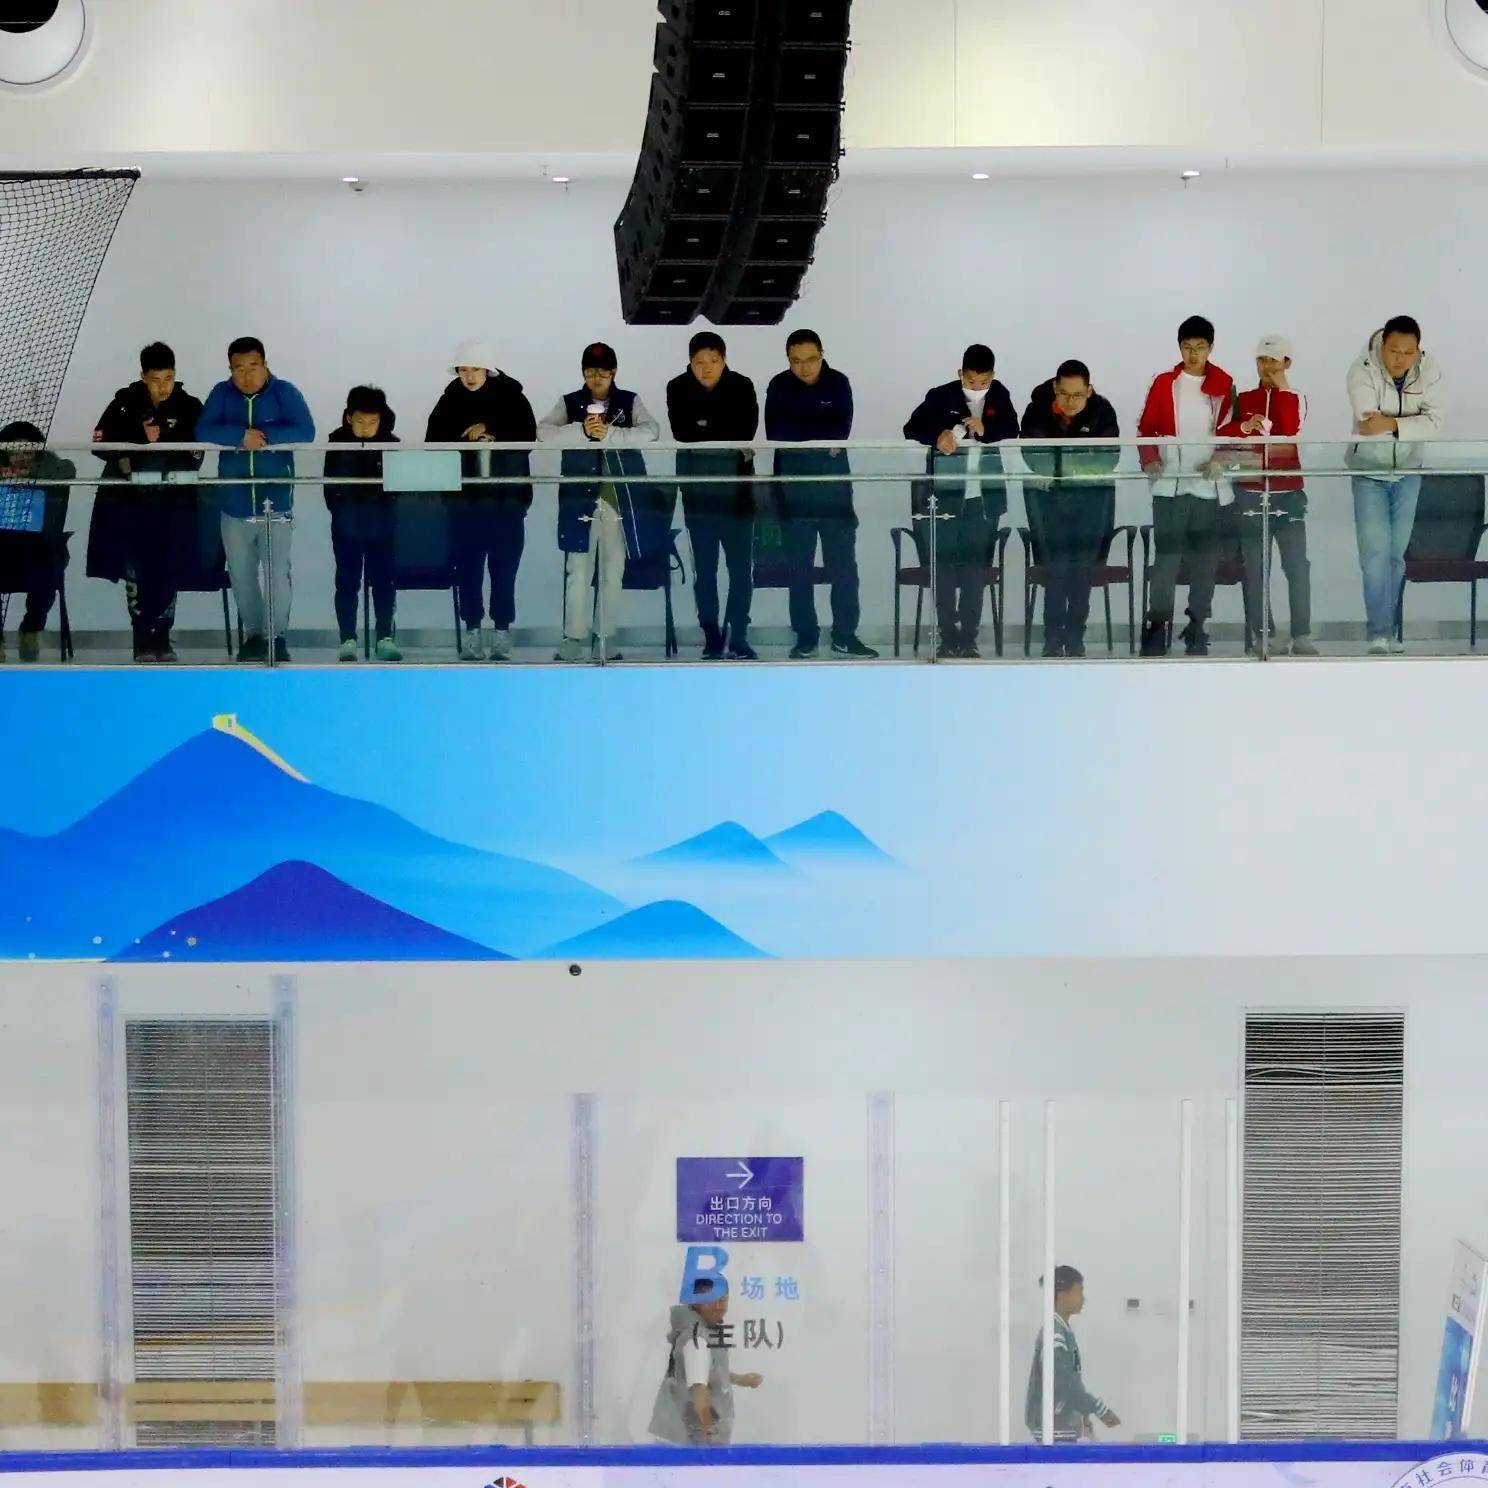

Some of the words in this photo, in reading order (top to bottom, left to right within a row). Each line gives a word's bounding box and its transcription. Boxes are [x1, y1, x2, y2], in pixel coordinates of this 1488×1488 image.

[710, 1196, 772, 1211] 出口方向
[695, 1213, 763, 1225] DIRECTION
[766, 1213, 782, 1224] TO
[714, 1227, 738, 1238] THE
[741, 1227, 768, 1238] EXIT
[679, 1246, 730, 1304] B
[740, 1276, 800, 1301] 场地
